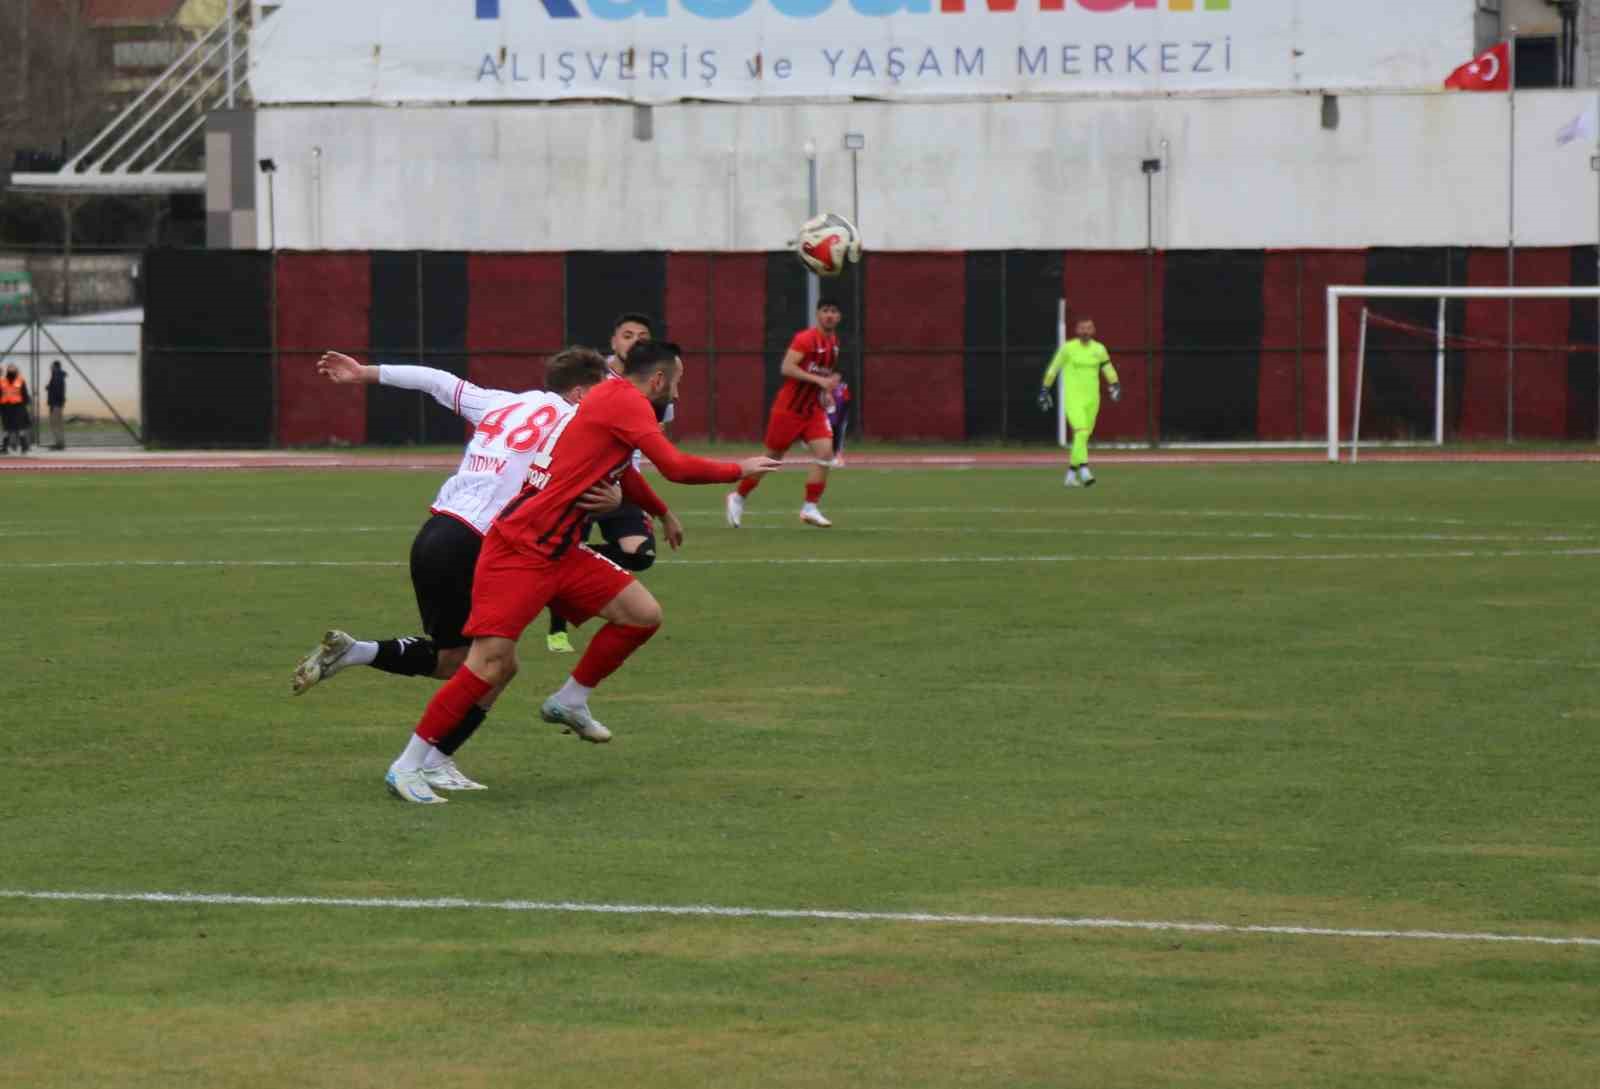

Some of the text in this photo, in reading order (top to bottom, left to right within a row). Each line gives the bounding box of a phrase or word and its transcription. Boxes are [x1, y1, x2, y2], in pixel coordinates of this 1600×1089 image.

[476, 36, 1232, 88] ALIŞVERİŞ ve YAŞAM MERKEZİ
